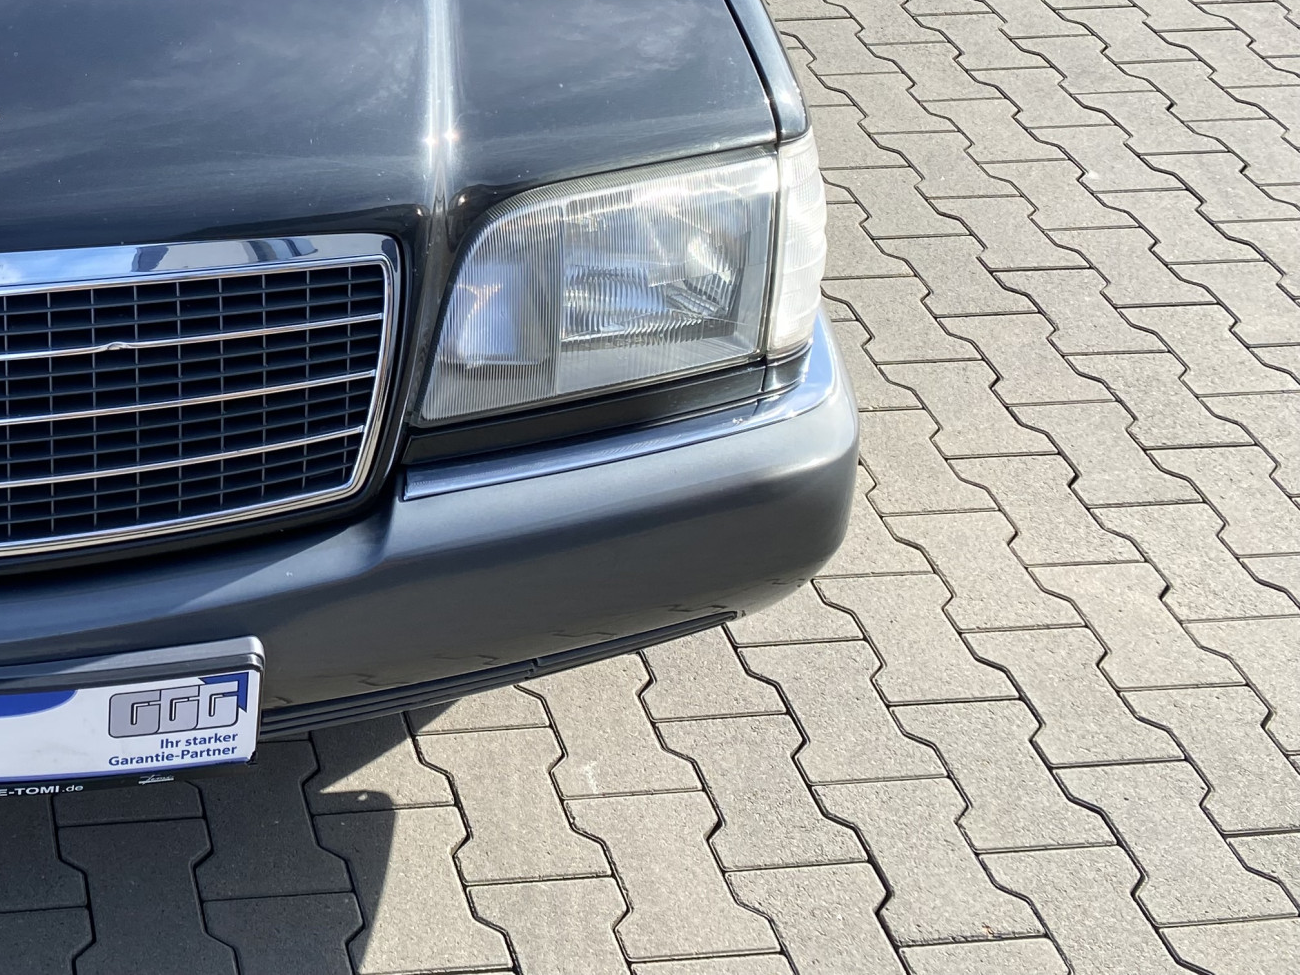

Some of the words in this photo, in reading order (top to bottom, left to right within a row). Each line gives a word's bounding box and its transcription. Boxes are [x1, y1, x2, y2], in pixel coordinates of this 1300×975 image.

[108, 680, 240, 739] GGG
[160, 738, 182, 750] Ihr
[185, 733, 239, 747] starker
[108, 745, 238, 767] Garantie-Partner
